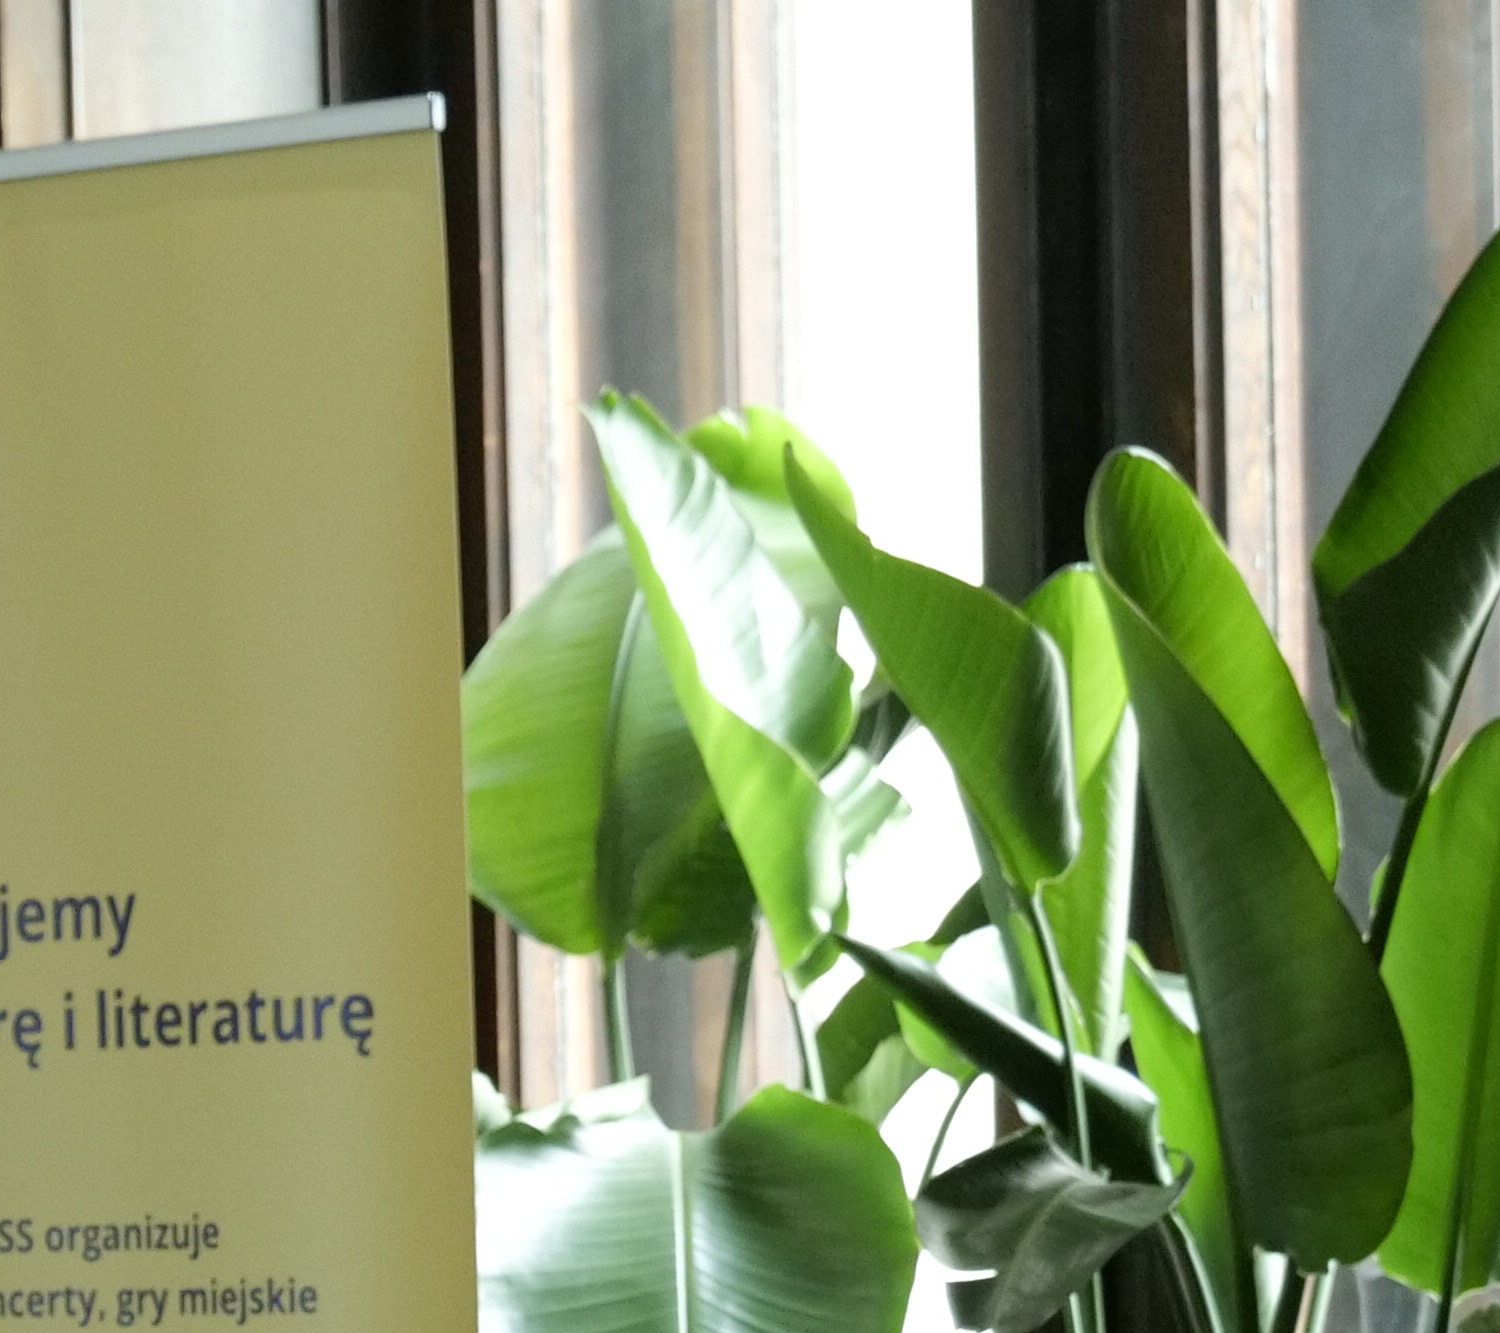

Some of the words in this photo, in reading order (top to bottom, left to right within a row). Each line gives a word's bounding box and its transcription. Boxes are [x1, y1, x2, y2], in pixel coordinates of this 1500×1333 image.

[64, 991, 76, 1050] i
[98, 988, 376, 1056] literaturę
[46, 1213, 220, 1260] organizuje
[117, 1288, 168, 1325] gry
[179, 1277, 318, 1324] miejskie
